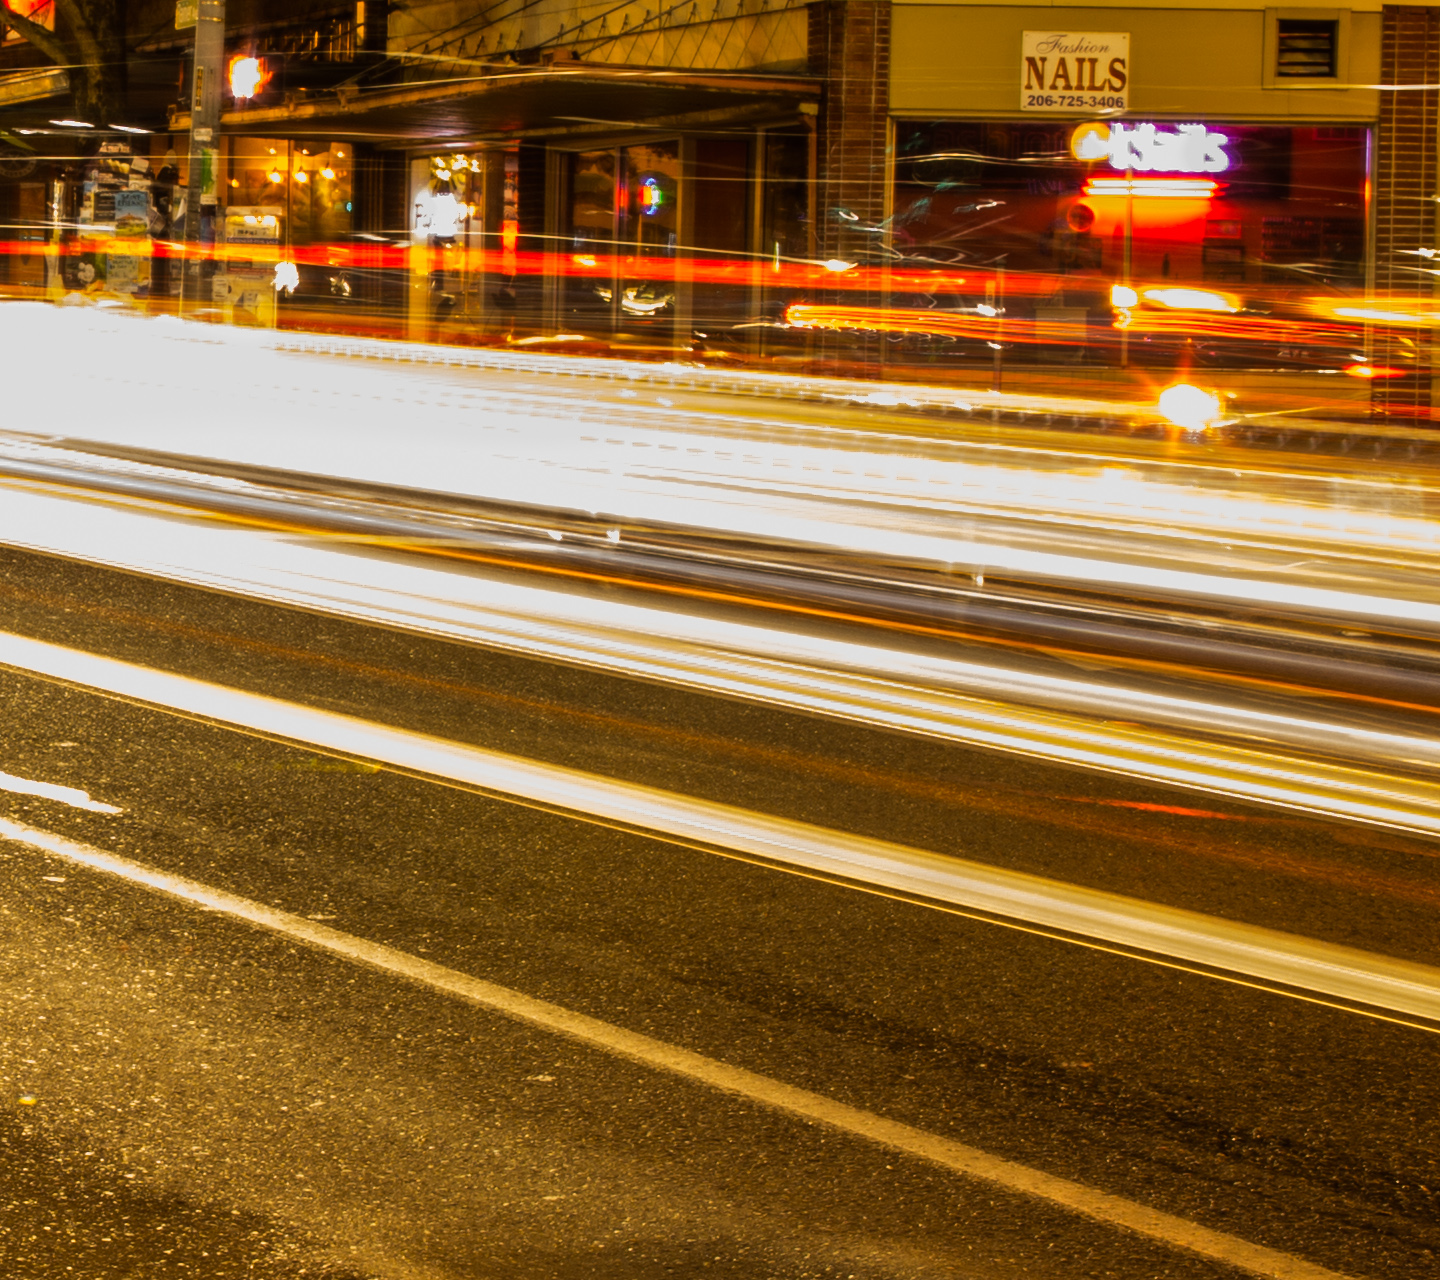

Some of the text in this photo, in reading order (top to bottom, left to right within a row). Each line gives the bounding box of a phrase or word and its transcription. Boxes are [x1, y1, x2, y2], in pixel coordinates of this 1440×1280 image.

[1035, 33, 1111, 55] Fashion
[1023, 55, 1128, 93] NAILS
[1026, 94, 1125, 109] 206-725-3406
